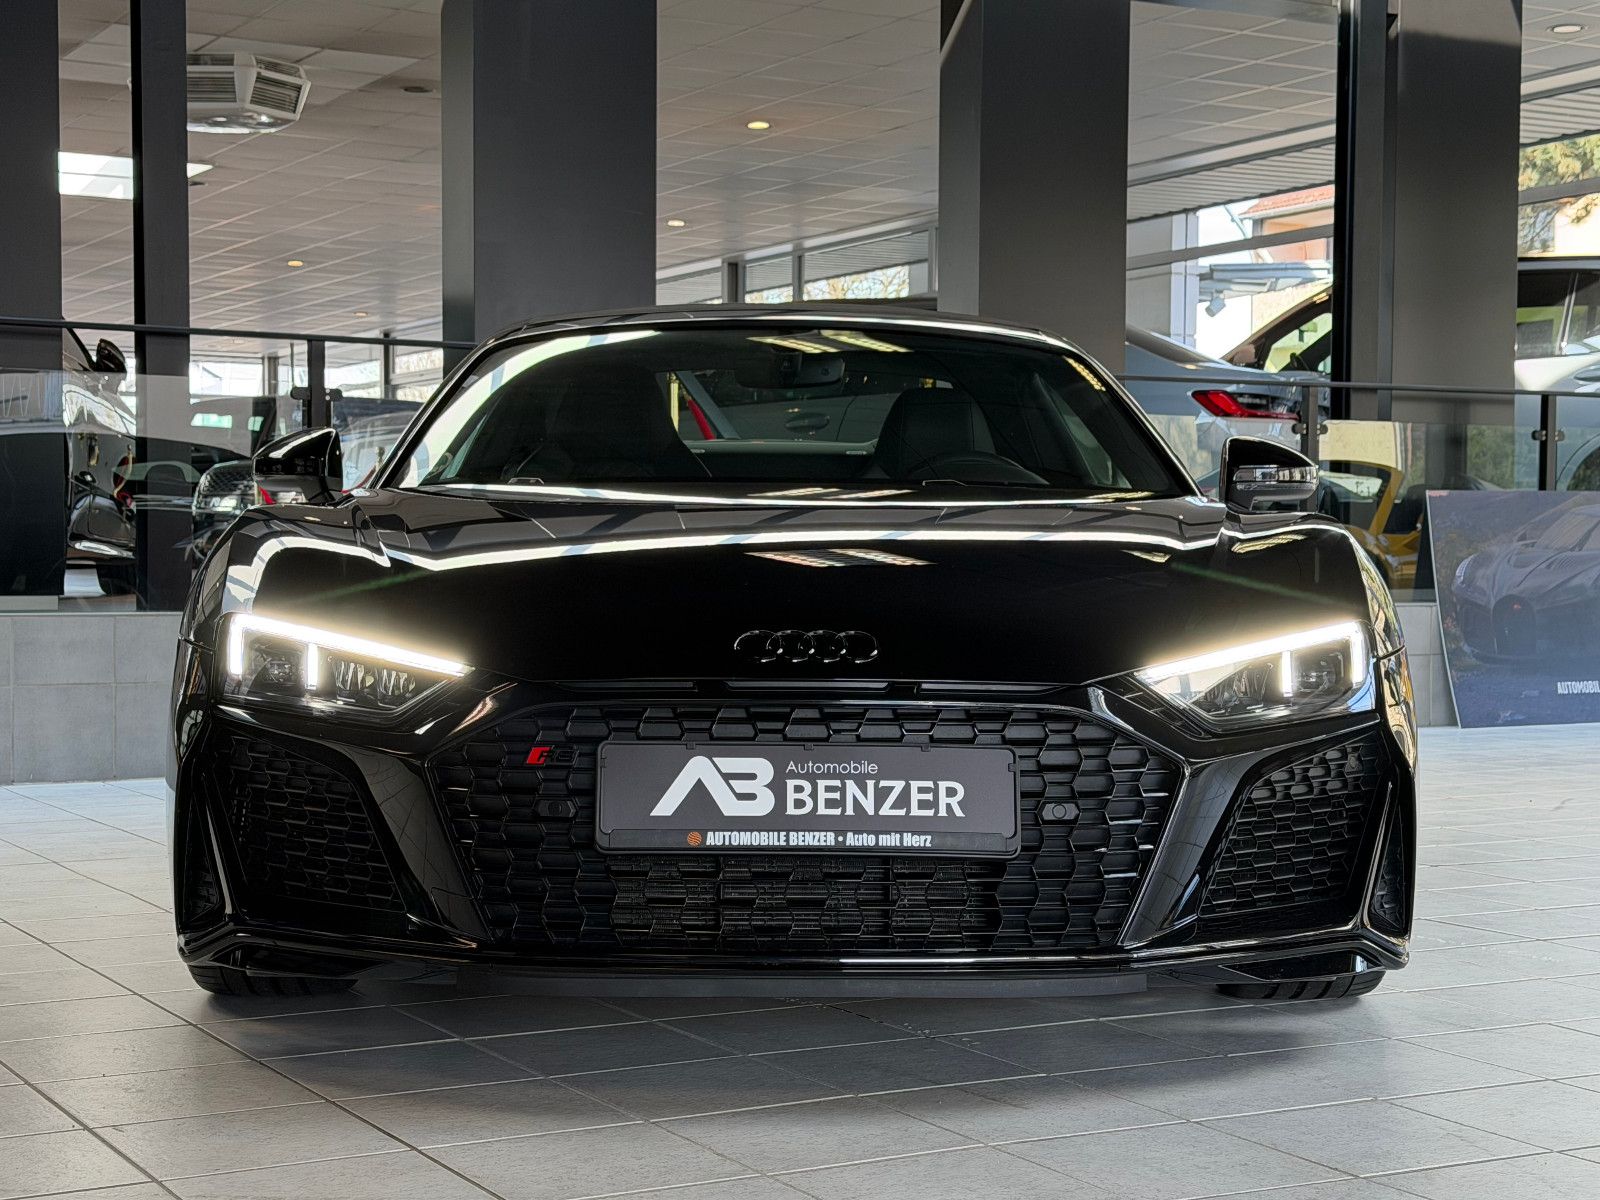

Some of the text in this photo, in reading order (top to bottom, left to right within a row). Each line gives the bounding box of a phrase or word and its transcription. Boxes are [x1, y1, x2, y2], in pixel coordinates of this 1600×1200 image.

[786, 760, 879, 774] Automobile
[785, 779, 966, 818] BENZER
[706, 831, 932, 848] AUTOMOBILE BENZER Auto mit Herz
